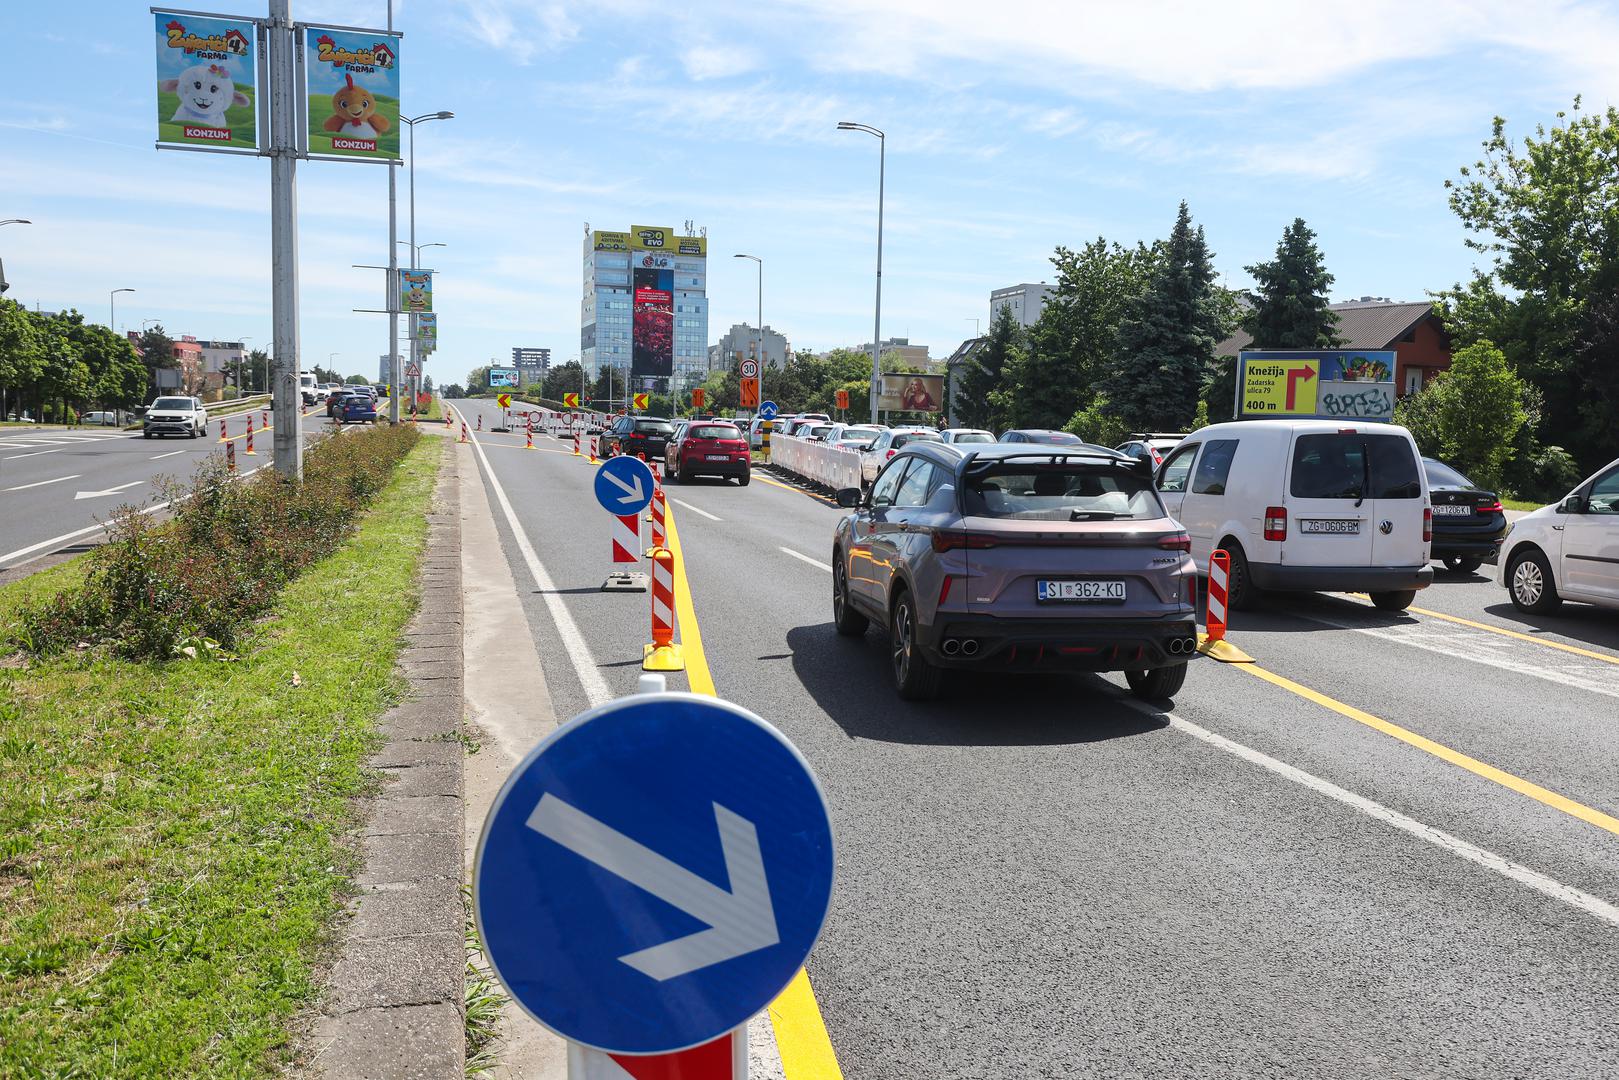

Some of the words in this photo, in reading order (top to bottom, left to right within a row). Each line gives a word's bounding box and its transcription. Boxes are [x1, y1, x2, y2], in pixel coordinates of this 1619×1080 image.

[196, 50, 228, 60] FARMA
[345, 64, 375, 73] FARMA
[186, 128, 229, 139] KONZUM
[334, 139, 375, 150] KONZUM
[655, 258, 667, 267] LG
[744, 365, 754, 373] 30
[1248, 366, 1284, 377] Knežija
[1246, 401, 1265, 410] 400
[1308, 521, 1320, 531] ZG
[1048, 582, 1062, 597] SI
[1075, 582, 1124, 597] 362-KD
